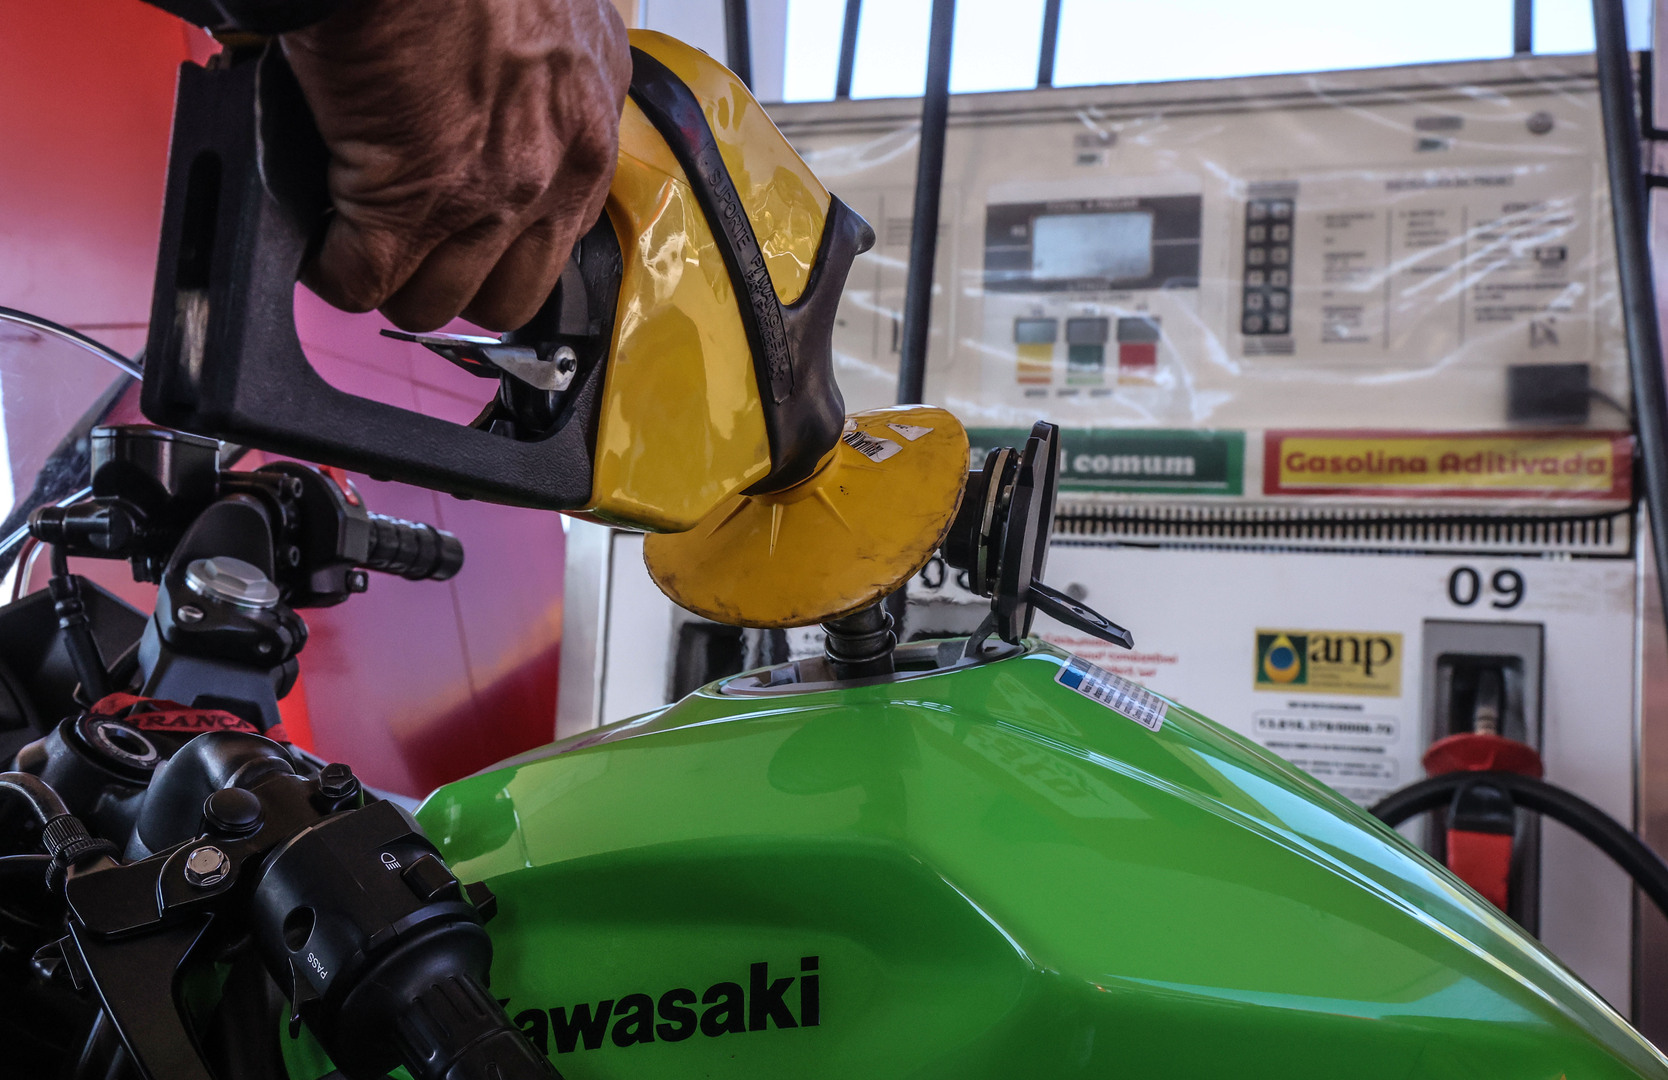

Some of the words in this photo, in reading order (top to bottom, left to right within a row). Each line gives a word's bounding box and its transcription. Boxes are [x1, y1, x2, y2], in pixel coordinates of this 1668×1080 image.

[709, 166, 750, 251] SUPORTE
[1073, 453, 1195, 475] comum
[1285, 450, 1428, 475] Gasolina
[1438, 450, 1607, 477] Aditivada
[1447, 566, 1524, 609] 09
[1310, 634, 1393, 677] anp
[307, 952, 328, 980] PASS
[499, 956, 819, 1055] awasaki
